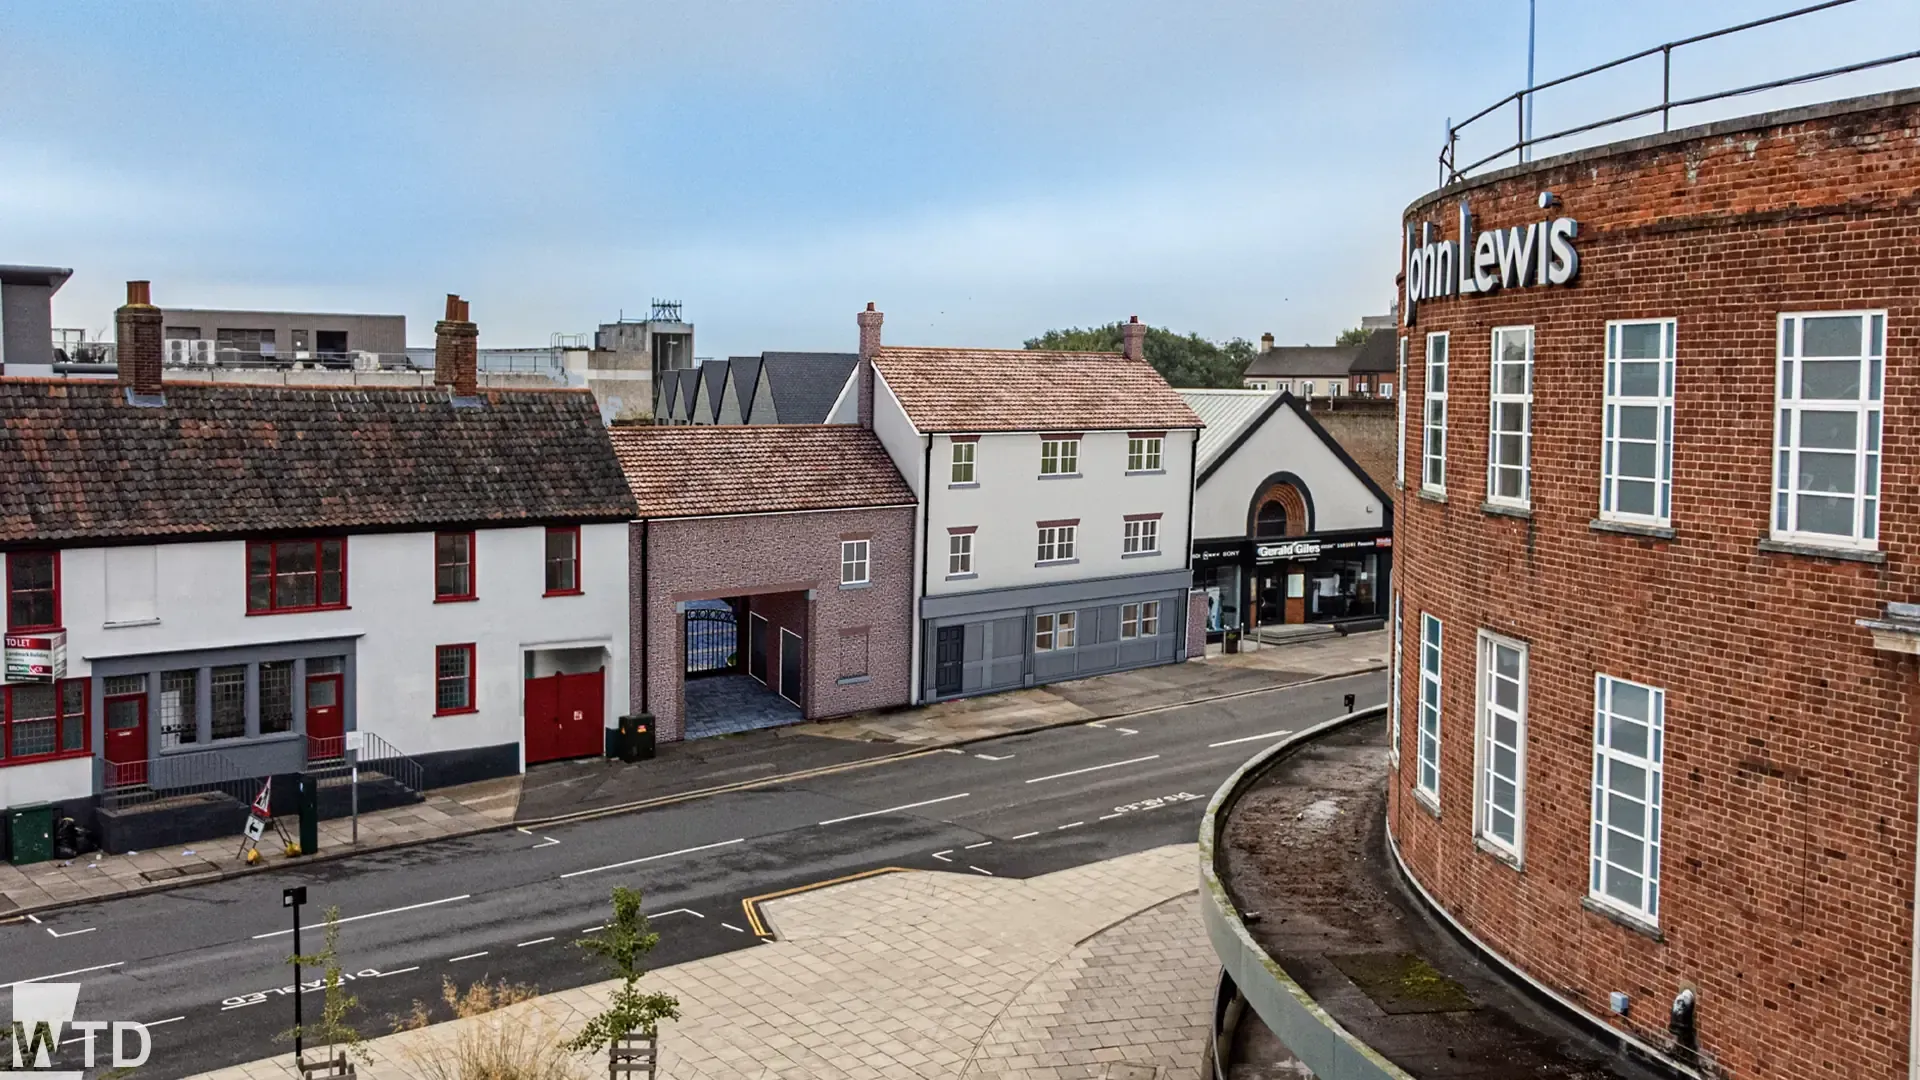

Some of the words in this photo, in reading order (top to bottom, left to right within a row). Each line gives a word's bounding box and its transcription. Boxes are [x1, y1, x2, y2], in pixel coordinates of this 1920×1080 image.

[1404, 220, 1458, 327] John
[1459, 191, 1578, 293] Lewis
[1258, 544, 1293, 557] Gerald
[1294, 543, 1321, 554] Giles
[6, 638, 16, 646] TO
[17, 639, 30, 648] LET
